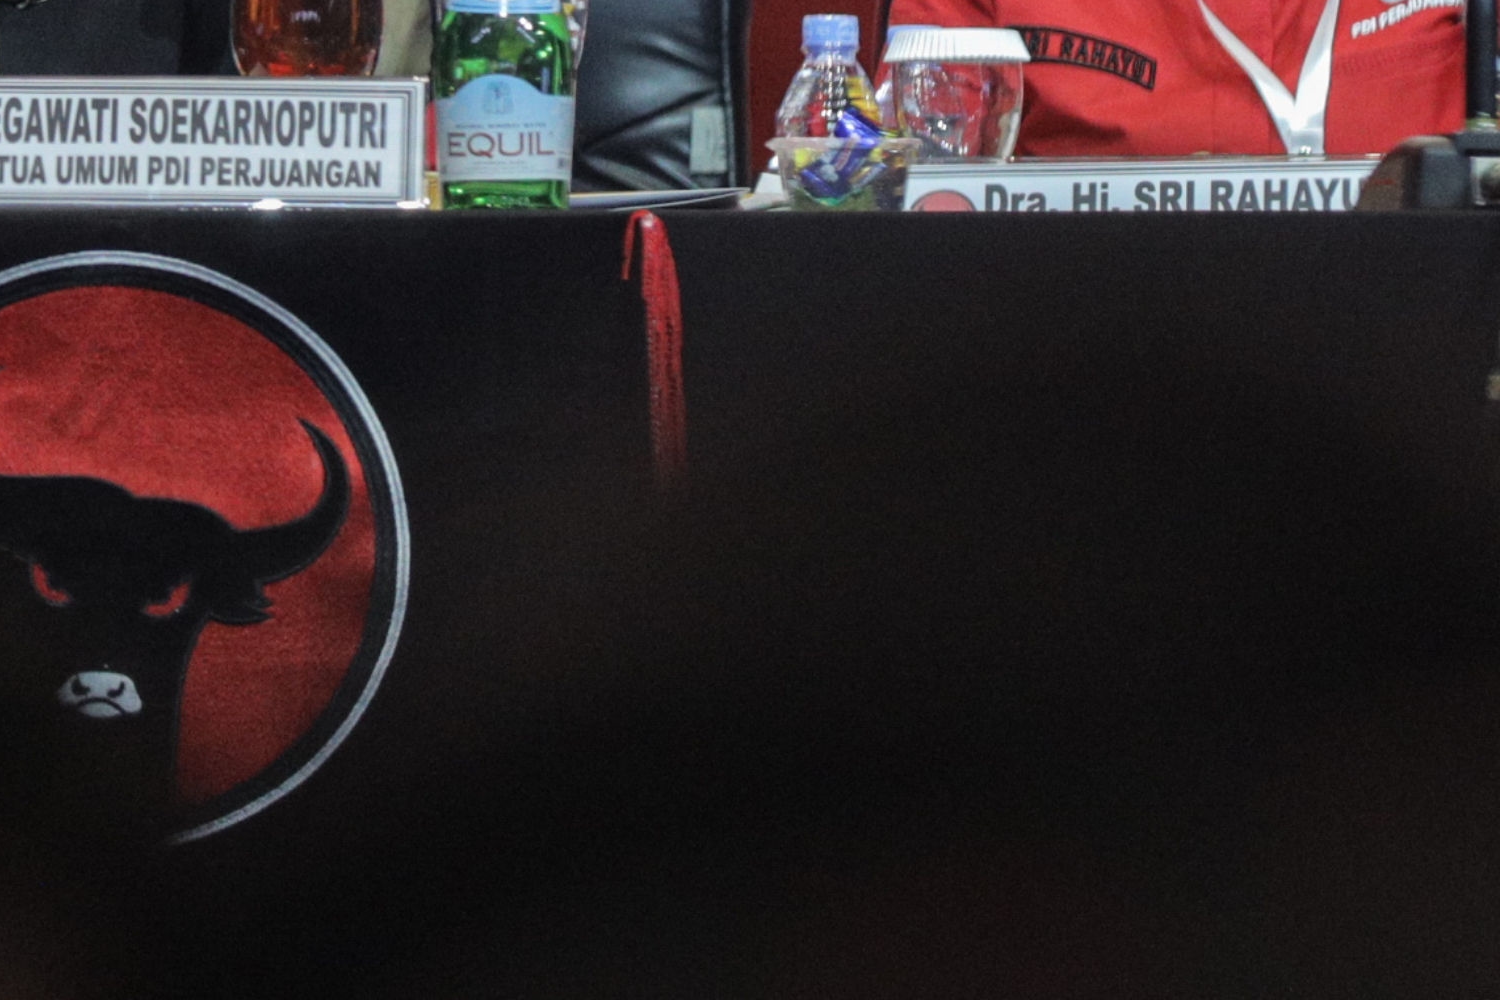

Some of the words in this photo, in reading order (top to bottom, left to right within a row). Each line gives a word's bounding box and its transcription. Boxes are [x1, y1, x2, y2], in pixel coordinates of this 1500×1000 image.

[1350, 15, 1377, 39] PDI
[129, 98, 387, 149] SOEKARNOPUTRI
[447, 131, 555, 158] EQUIL
[56, 156, 138, 185] UMUM
[147, 156, 190, 186] PDI
[200, 157, 382, 188] PERJUANGAN
[985, 184, 1059, 211] Dra.
[1134, 180, 1195, 211] SRI
[1211, 178, 1366, 211] RAHAYU
